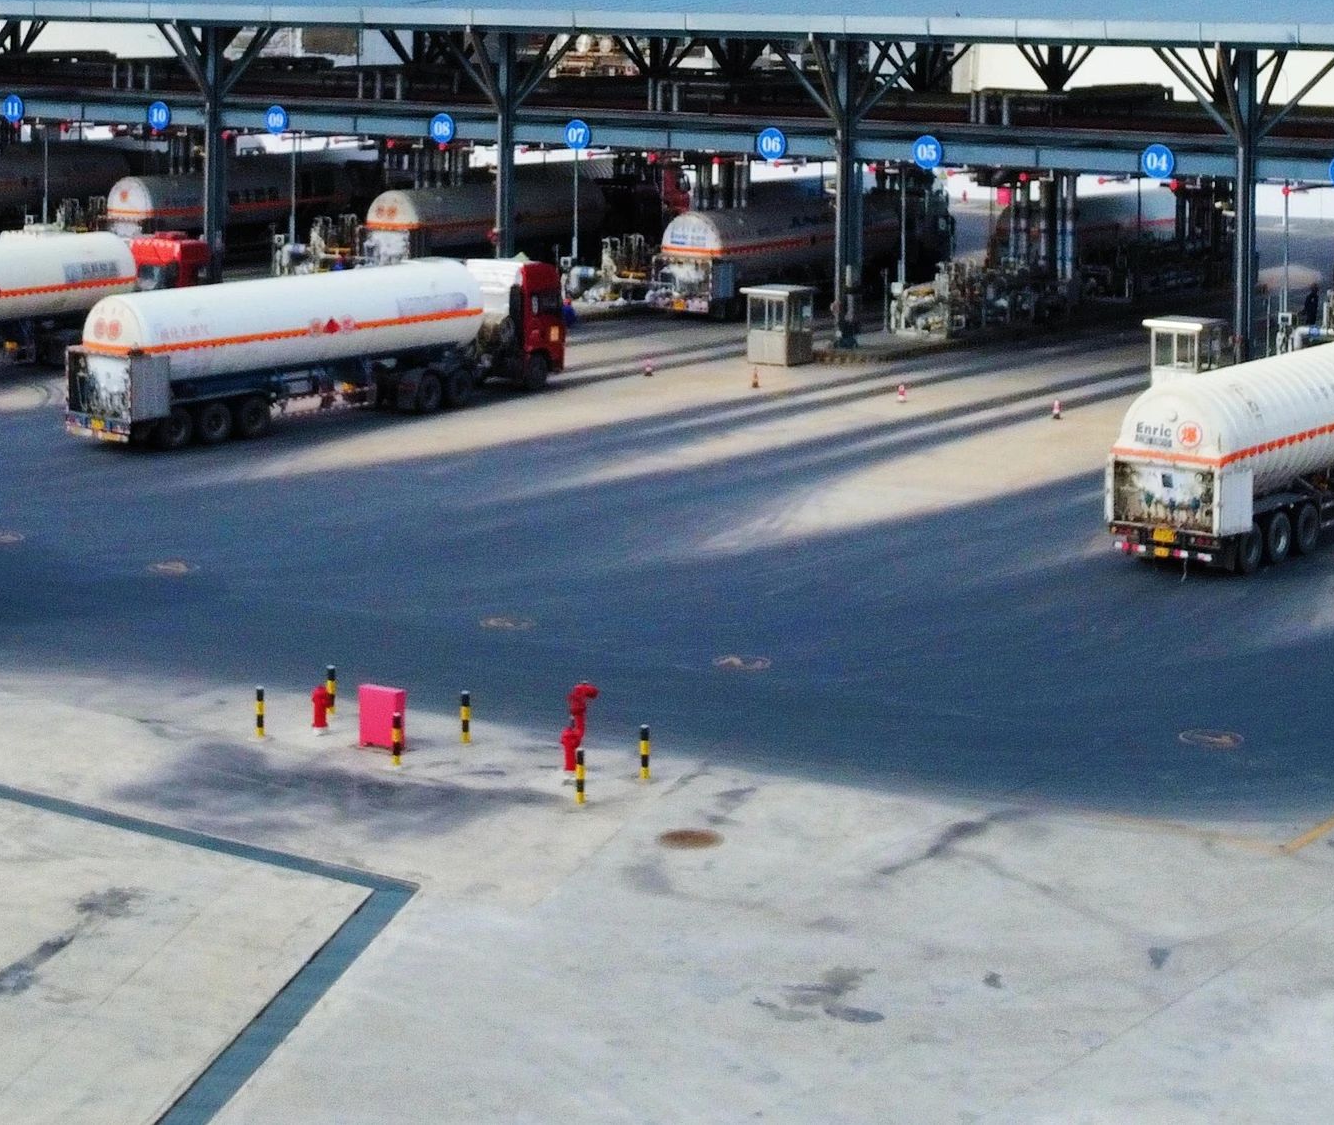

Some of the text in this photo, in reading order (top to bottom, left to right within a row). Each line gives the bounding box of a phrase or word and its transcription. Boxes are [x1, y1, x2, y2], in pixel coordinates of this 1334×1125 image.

[7, 102, 19, 116] 11
[152, 108, 166, 122] 10
[268, 113, 283, 127] 09
[434, 121, 450, 136] 08
[568, 127, 585, 142] 07
[762, 136, 781, 152] 06
[917, 144, 936, 161] 05
[1146, 153, 1167, 171] 04
[1135, 421, 1172, 438] Enric
